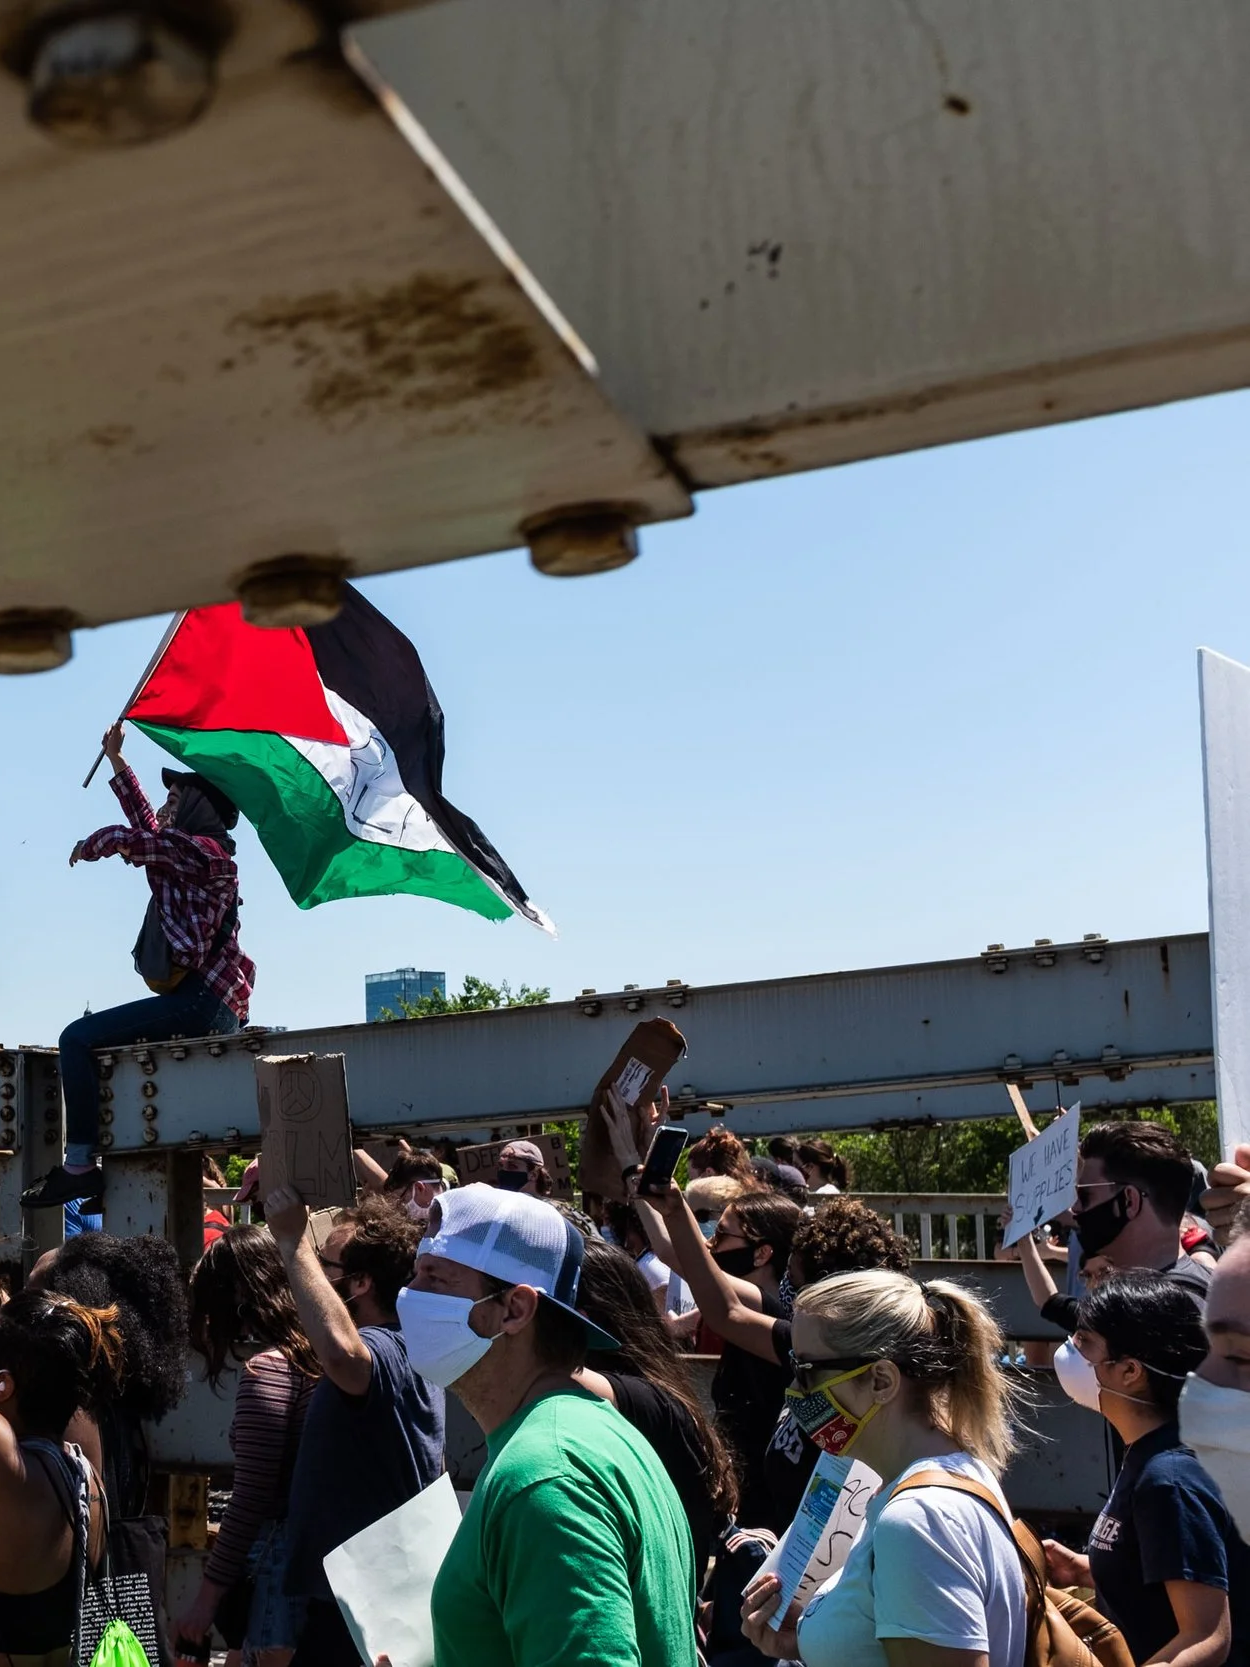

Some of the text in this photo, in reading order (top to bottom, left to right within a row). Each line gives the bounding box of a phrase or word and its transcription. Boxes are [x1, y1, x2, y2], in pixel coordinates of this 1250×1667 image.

[1021, 1127, 1071, 1184] WE HAVE
[1015, 1158, 1073, 1223] SUPPLIES
